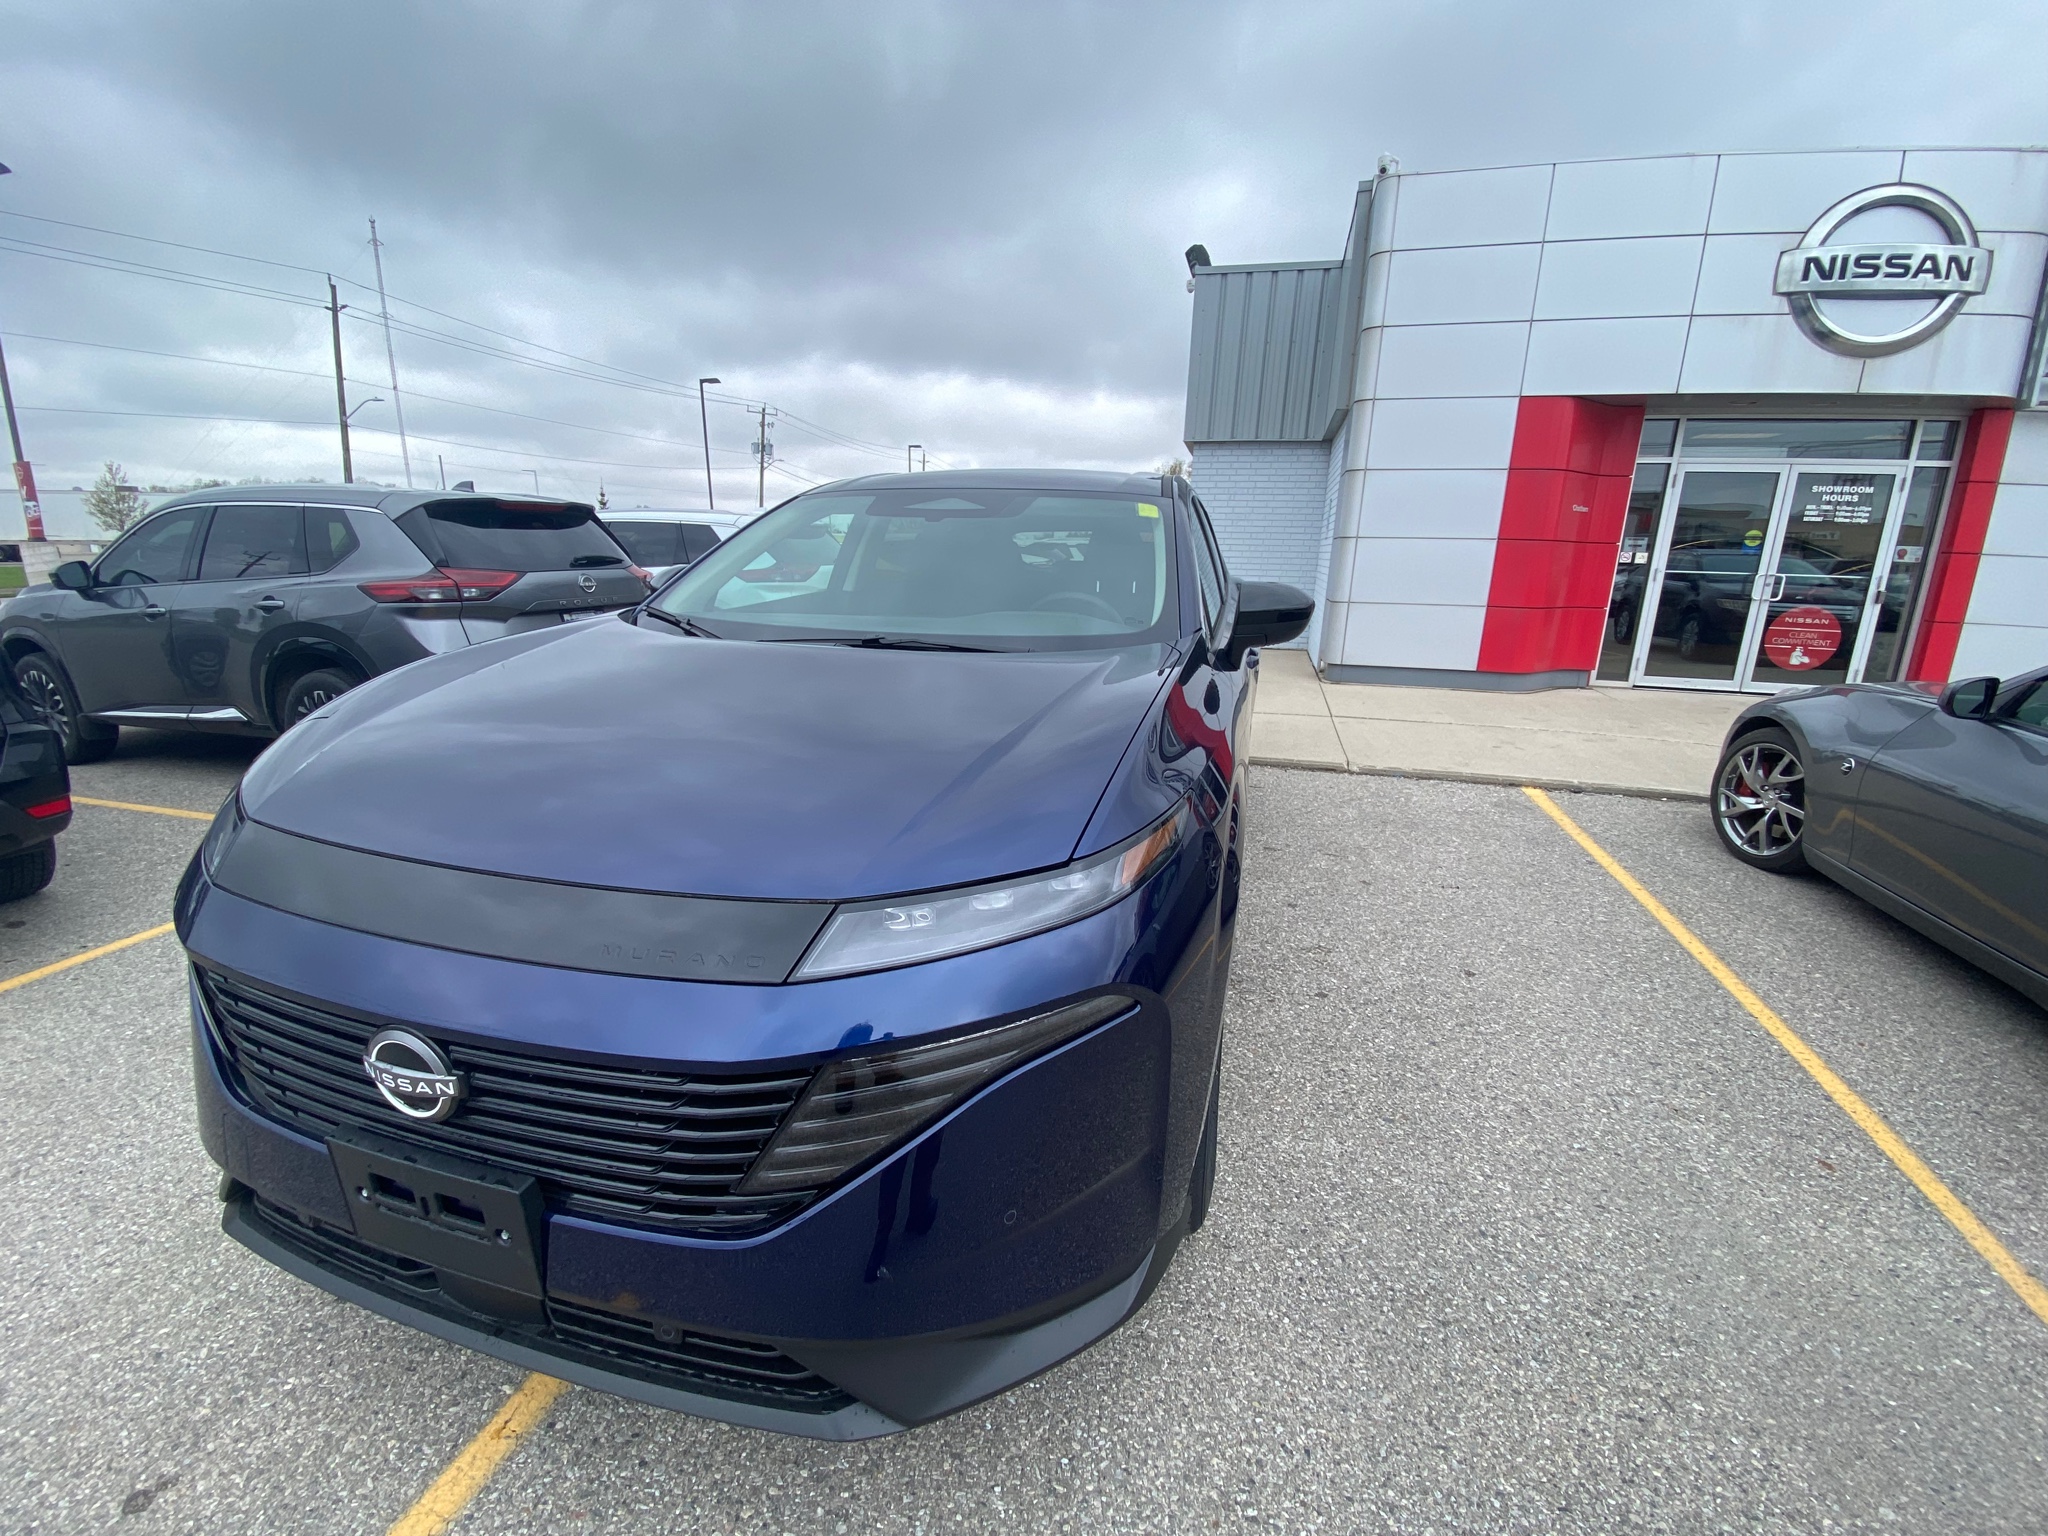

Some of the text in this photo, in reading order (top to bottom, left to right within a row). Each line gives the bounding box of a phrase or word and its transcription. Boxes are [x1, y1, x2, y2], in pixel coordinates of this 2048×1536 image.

[1801, 253, 1975, 282] NISSAN
[1811, 485, 1875, 494] SHOWROOM
[1822, 494, 1860, 502] HOURS
[1789, 631, 1818, 639] CLEAN
[1772, 637, 1832, 647] COMMITMENT
[601, 944, 766, 968] MURANO
[364, 1061, 455, 1095] NISSAN
